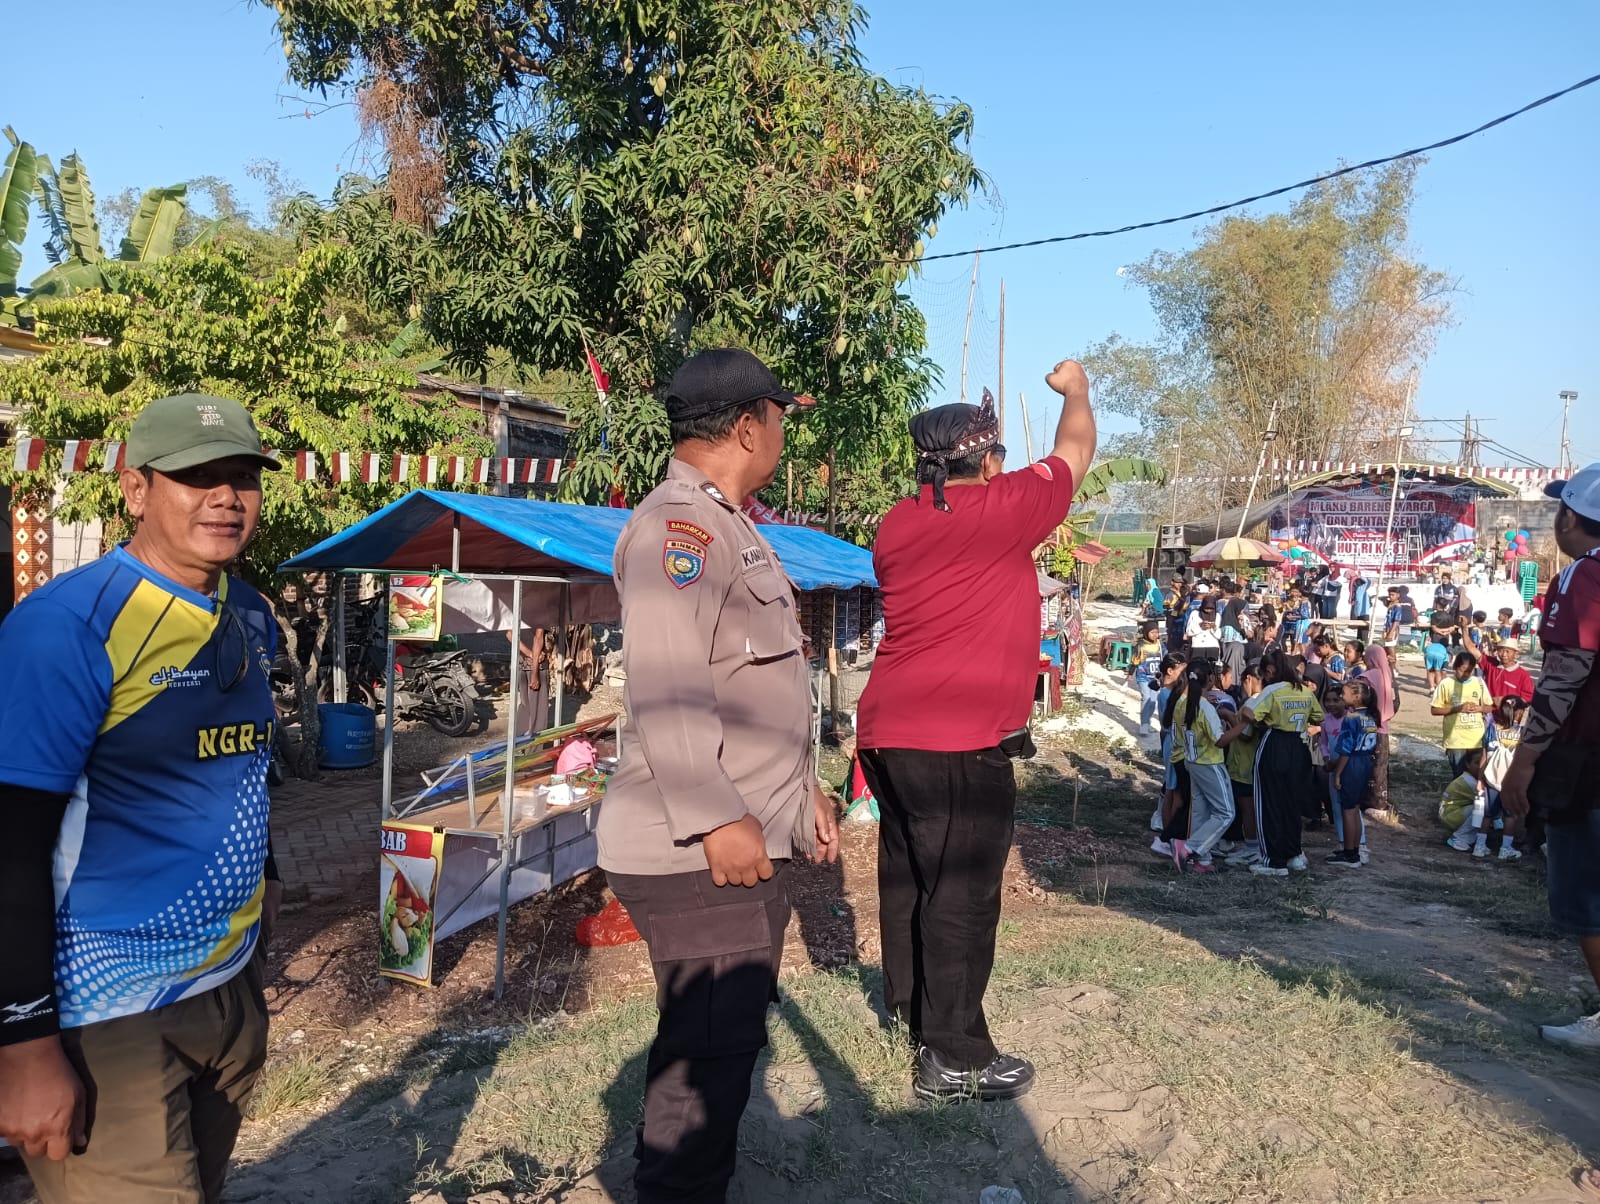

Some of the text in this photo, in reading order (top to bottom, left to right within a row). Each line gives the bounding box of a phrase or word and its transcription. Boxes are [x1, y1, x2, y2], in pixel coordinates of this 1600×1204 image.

[1326, 516, 1348, 526] DAN
[671, 522, 708, 541] BAHARKAM
[1337, 543, 1359, 554] HUT
[1361, 543, 1373, 554] RI
